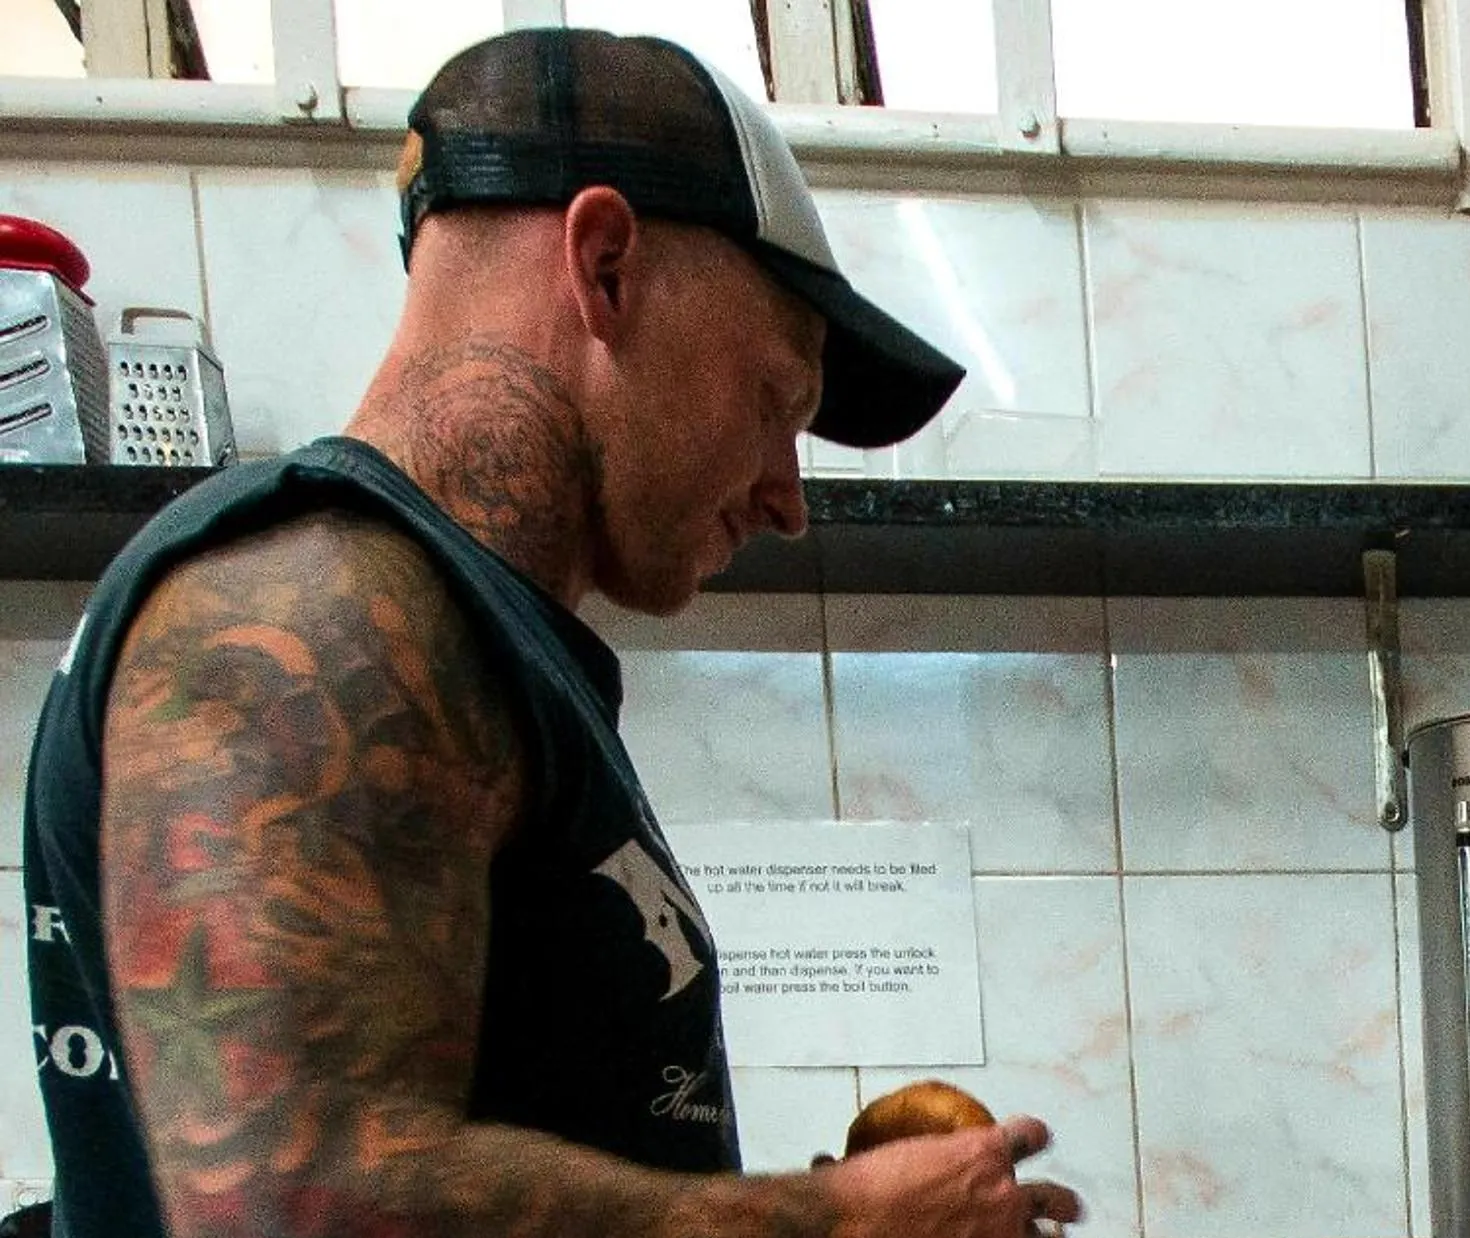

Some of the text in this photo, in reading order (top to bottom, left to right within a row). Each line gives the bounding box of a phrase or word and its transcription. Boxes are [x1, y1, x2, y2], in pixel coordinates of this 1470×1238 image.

[704, 864, 724, 876] hot
[728, 865, 762, 875] water
[766, 864, 828, 877] dispenser
[831, 865, 871, 875] needs
[873, 865, 886, 875] to
[889, 864, 906, 875] be
[707, 884, 723, 894] up
[727, 881, 741, 893] all
[744, 881, 765, 893] the
[767, 881, 795, 893] time
[809, 881, 830, 893] not
[832, 881, 842, 893] it
[845, 880, 864, 892] will
[868, 881, 907, 893] break.
[719, 950, 767, 961] ispense
[769, 948, 790, 960] hot
[794, 949, 828, 960] water
[832, 950, 867, 961] press
[871, 948, 891, 959] the
[733, 966, 756, 977] and
[866, 967, 890, 978] you
[894, 966, 924, 976] want
[927, 964, 940, 976] to
[743, 982, 777, 993] water
[781, 983, 816, 994] press
[820, 982, 840, 993] the
